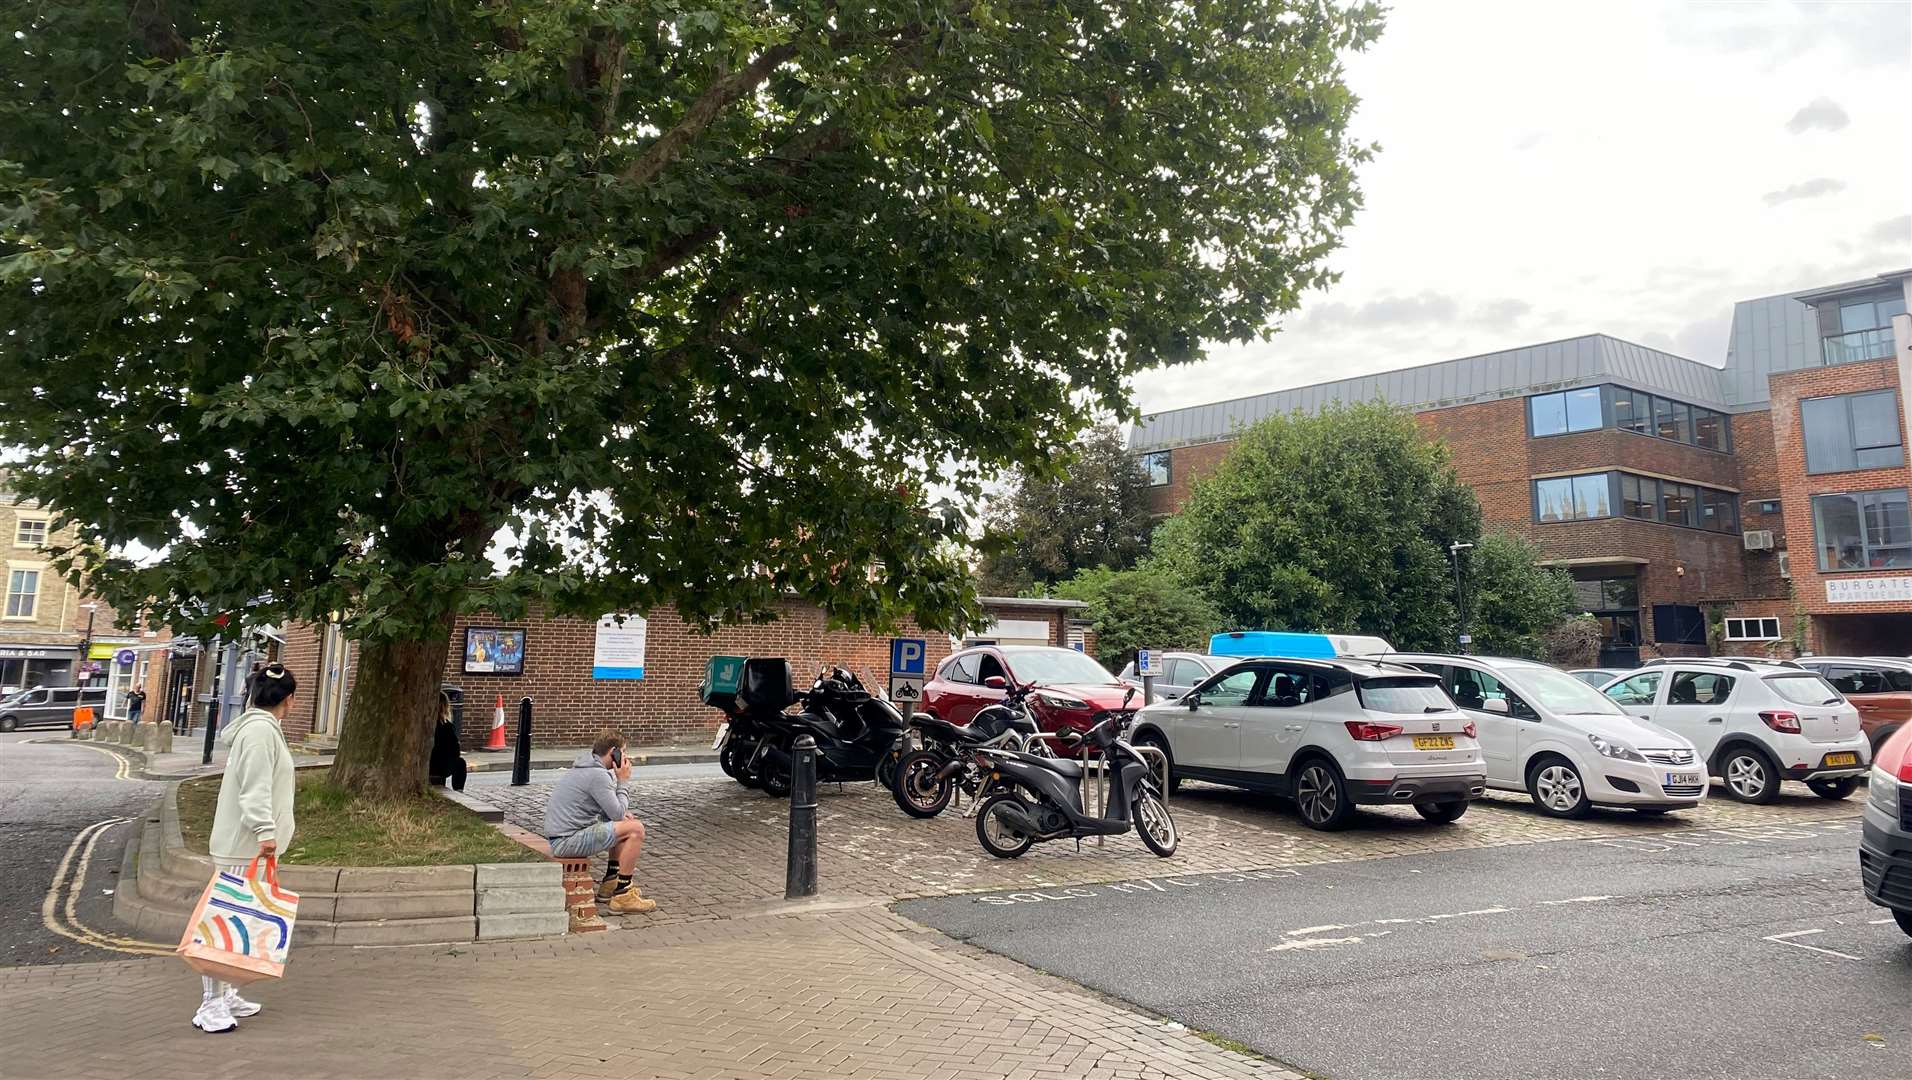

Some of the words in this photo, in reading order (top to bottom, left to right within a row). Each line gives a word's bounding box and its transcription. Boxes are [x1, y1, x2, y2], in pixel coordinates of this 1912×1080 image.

[1830, 579, 1911, 591] BURGATE
[1831, 591, 1911, 601] APARTMENTS
[901, 643, 920, 670] P
[977, 888, 1098, 905] SOLO
